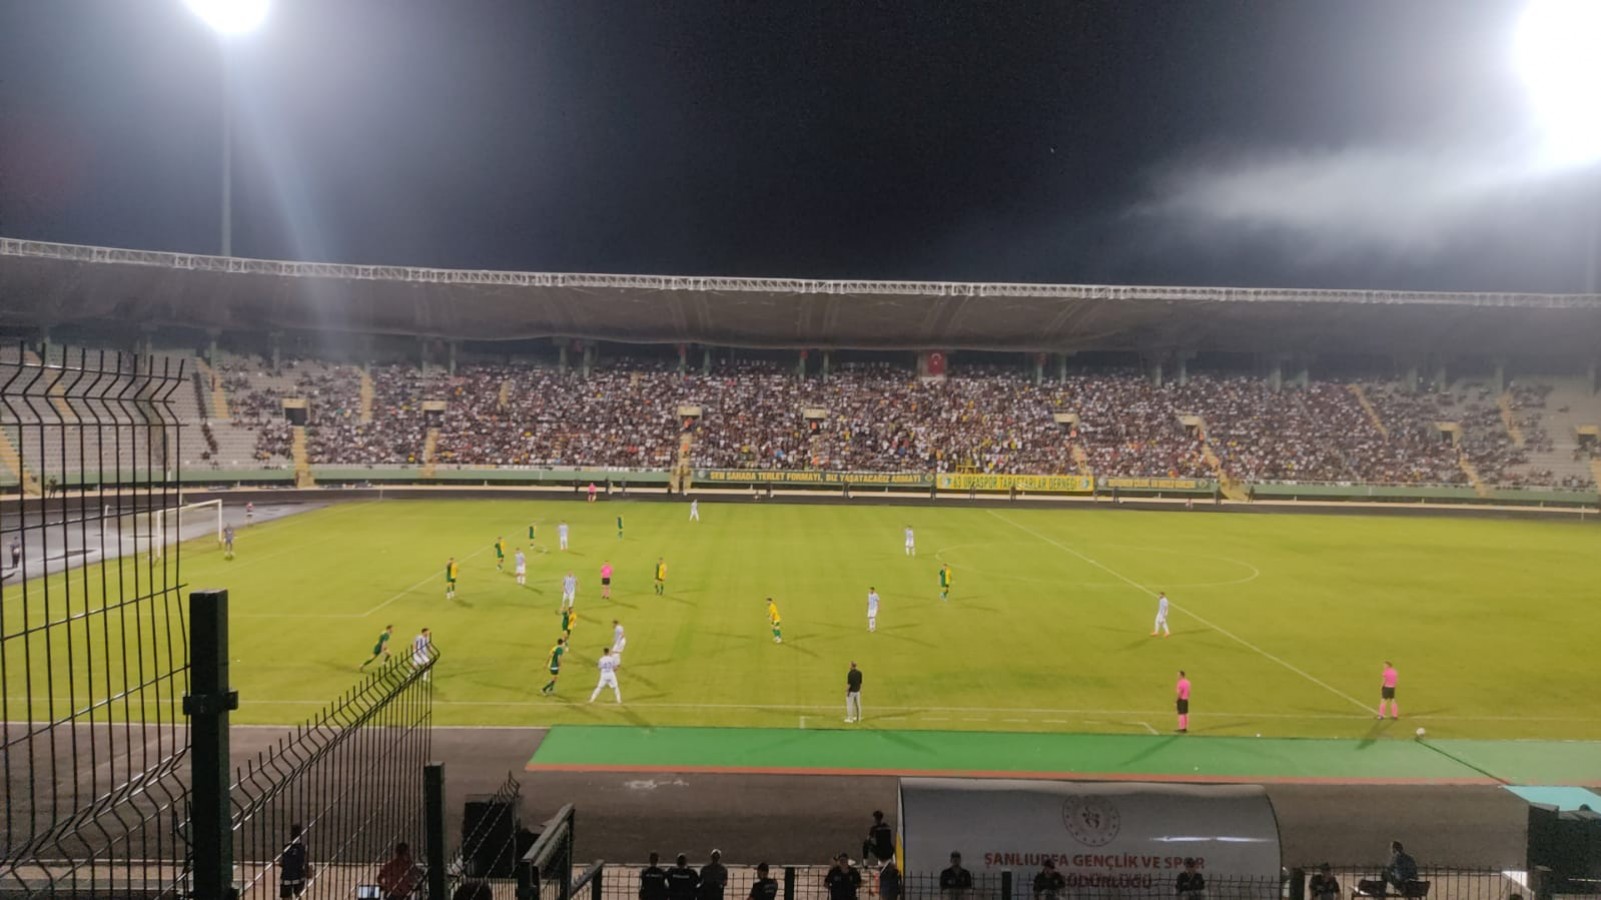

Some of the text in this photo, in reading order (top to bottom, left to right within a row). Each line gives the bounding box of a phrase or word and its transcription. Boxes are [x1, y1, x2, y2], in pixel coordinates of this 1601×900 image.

[1072, 852, 1138, 870] GENÇLİK
[1141, 856, 1160, 868] VE
[1066, 872, 1152, 888] ÜDÜRLÜĞÜ
